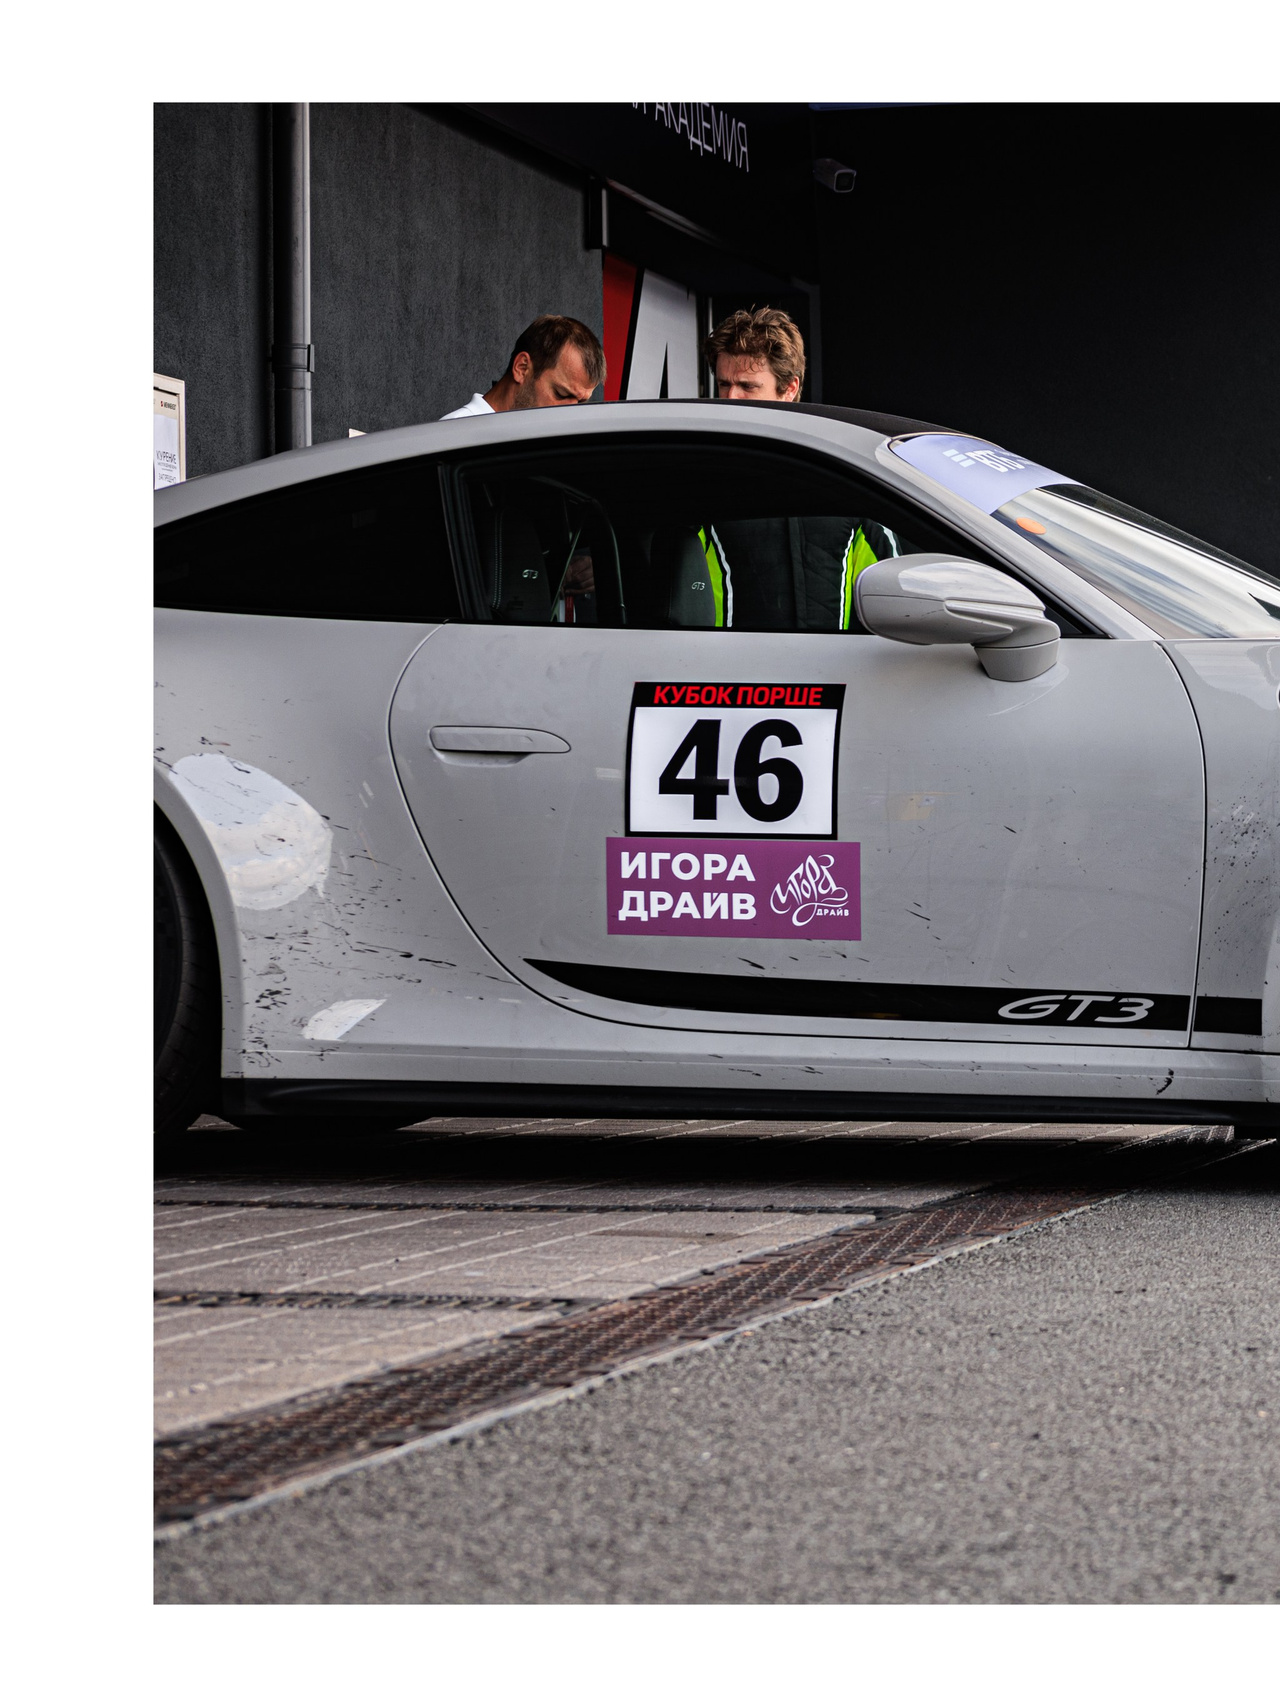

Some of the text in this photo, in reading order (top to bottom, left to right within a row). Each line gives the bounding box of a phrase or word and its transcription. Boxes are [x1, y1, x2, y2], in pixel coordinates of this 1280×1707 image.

[522, 569, 539, 579] GT3
[691, 581, 706, 590] GT3
[653, 685, 823, 706] КУБОК ПОРШЕ
[658, 718, 804, 823] 46
[620, 851, 756, 882] ИГОРА
[618, 890, 757, 922] ДРАЙВ
[816, 907, 849, 917] ДРАЙВ
[998, 994, 1155, 1023] GT3
